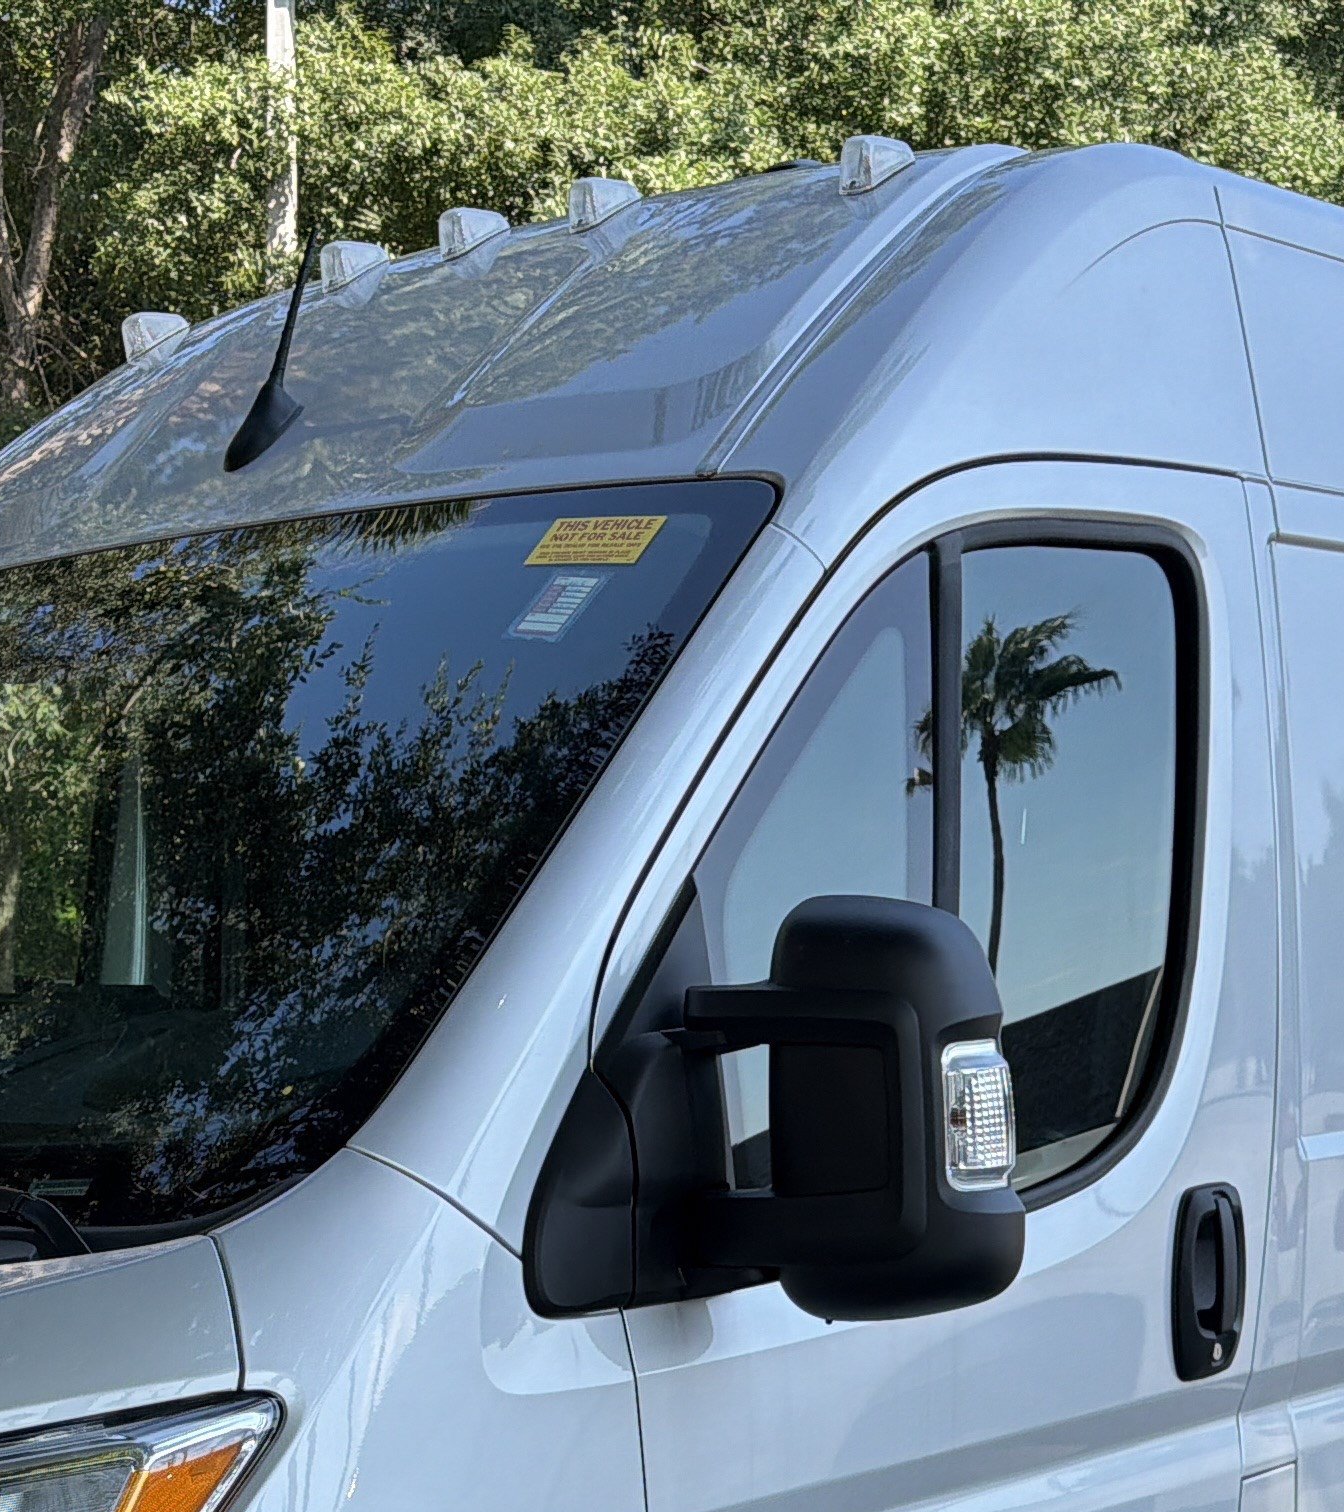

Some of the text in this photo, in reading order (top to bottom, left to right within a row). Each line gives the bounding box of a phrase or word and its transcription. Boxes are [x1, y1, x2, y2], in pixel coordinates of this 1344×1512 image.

[556, 518, 657, 532] THIS VEHICLE
[550, 531, 645, 542] NOT FOR SALE
